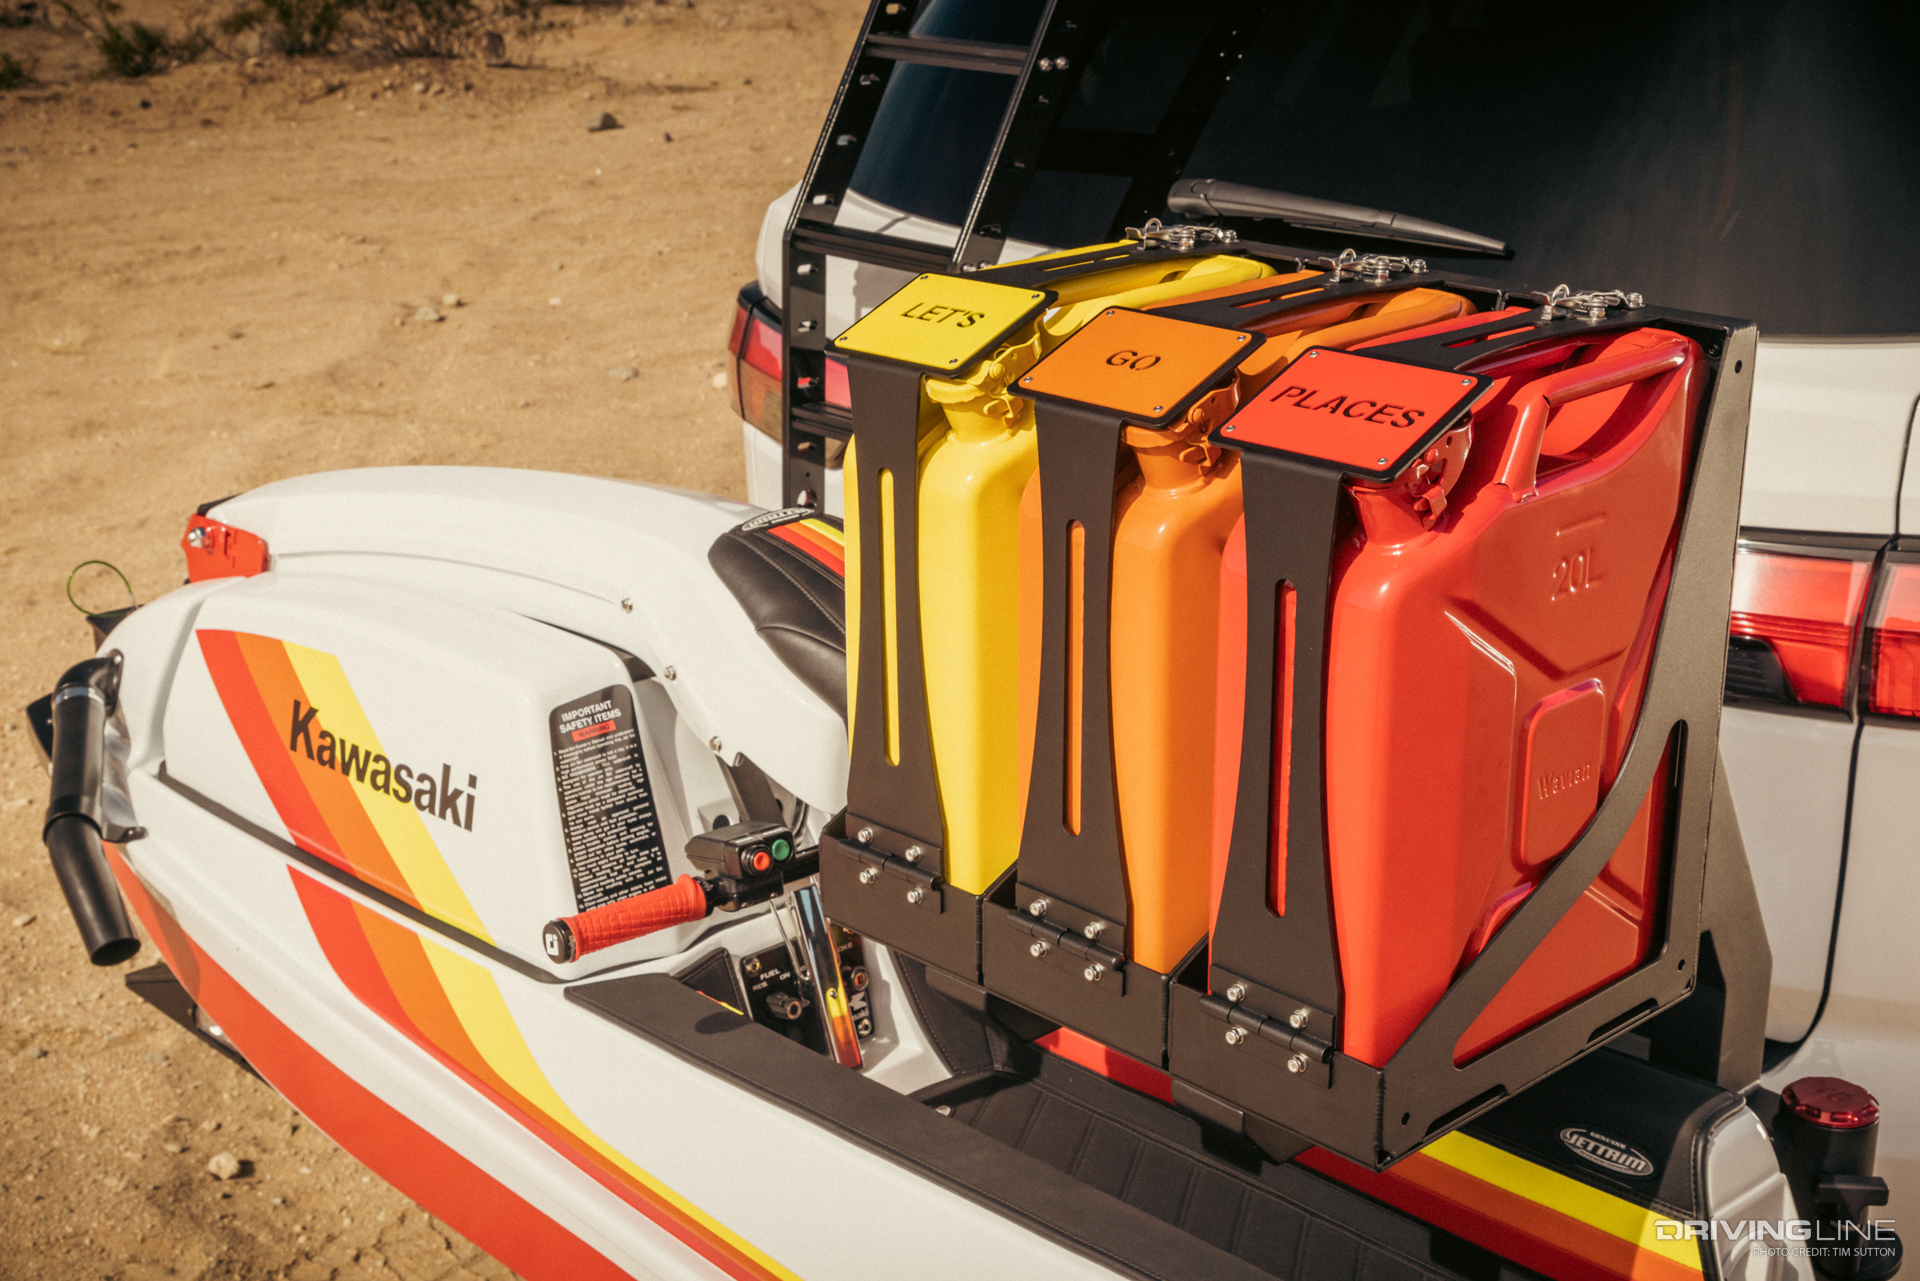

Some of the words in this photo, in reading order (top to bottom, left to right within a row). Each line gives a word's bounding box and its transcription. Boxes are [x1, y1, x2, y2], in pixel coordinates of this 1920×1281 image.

[900, 302, 985, 328] LET'S
[1105, 349, 1162, 371] GO
[1269, 385, 1425, 428] PLACES
[1551, 548, 1602, 602] 20L
[559, 717, 593, 733] SAFETY
[594, 709, 621, 723] ITEMS
[561, 700, 612, 722] IMPORTANT
[578, 724, 610, 738] WARNING
[289, 699, 478, 833] Kawasaki
[760, 968, 781, 980] FUEL
[779, 971, 791, 981] ON
[1563, 1130, 1647, 1171] JETTRIM
[1590, 1132, 1627, 1149] GENUINE
